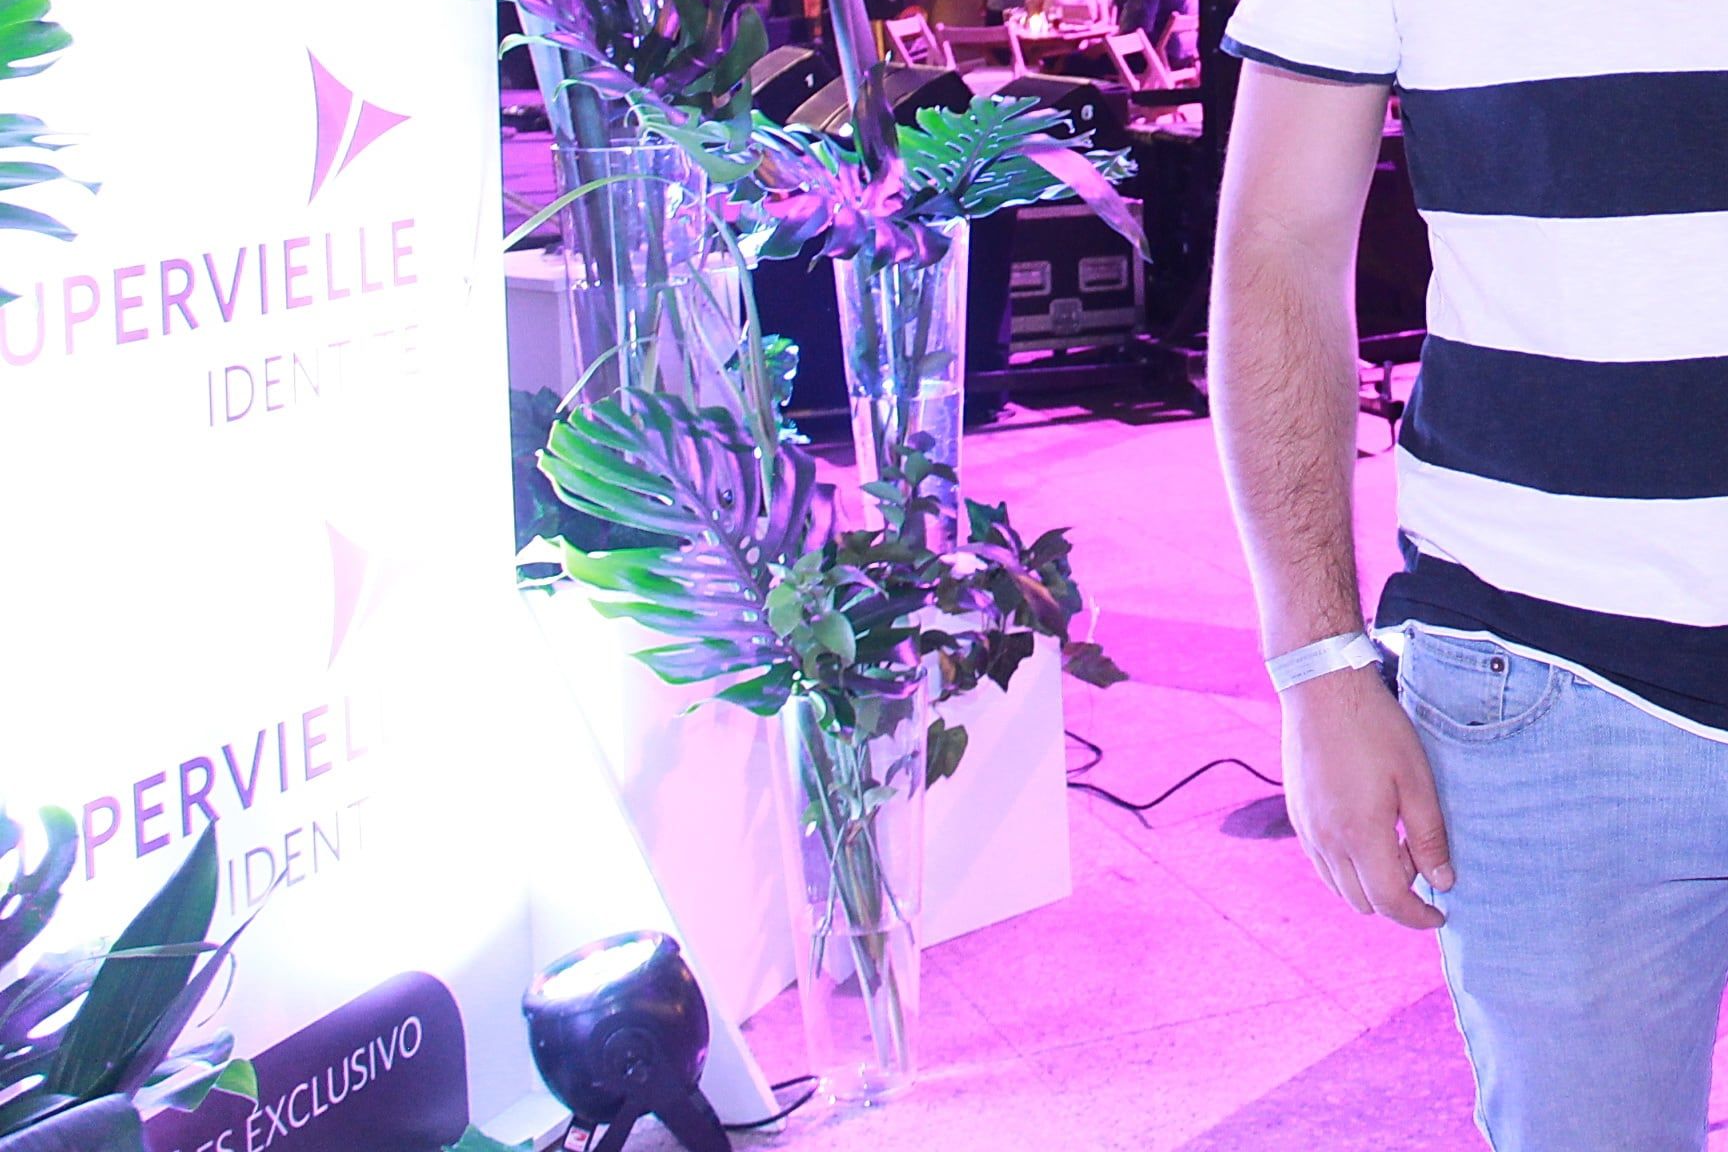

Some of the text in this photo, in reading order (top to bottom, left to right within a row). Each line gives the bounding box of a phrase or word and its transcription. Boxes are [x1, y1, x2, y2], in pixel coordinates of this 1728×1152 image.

[805, 73, 814, 87] 1
[0, 217, 418, 366] UPERVIELLE
[246, 1016, 422, 1152] EXCLUSIVO
